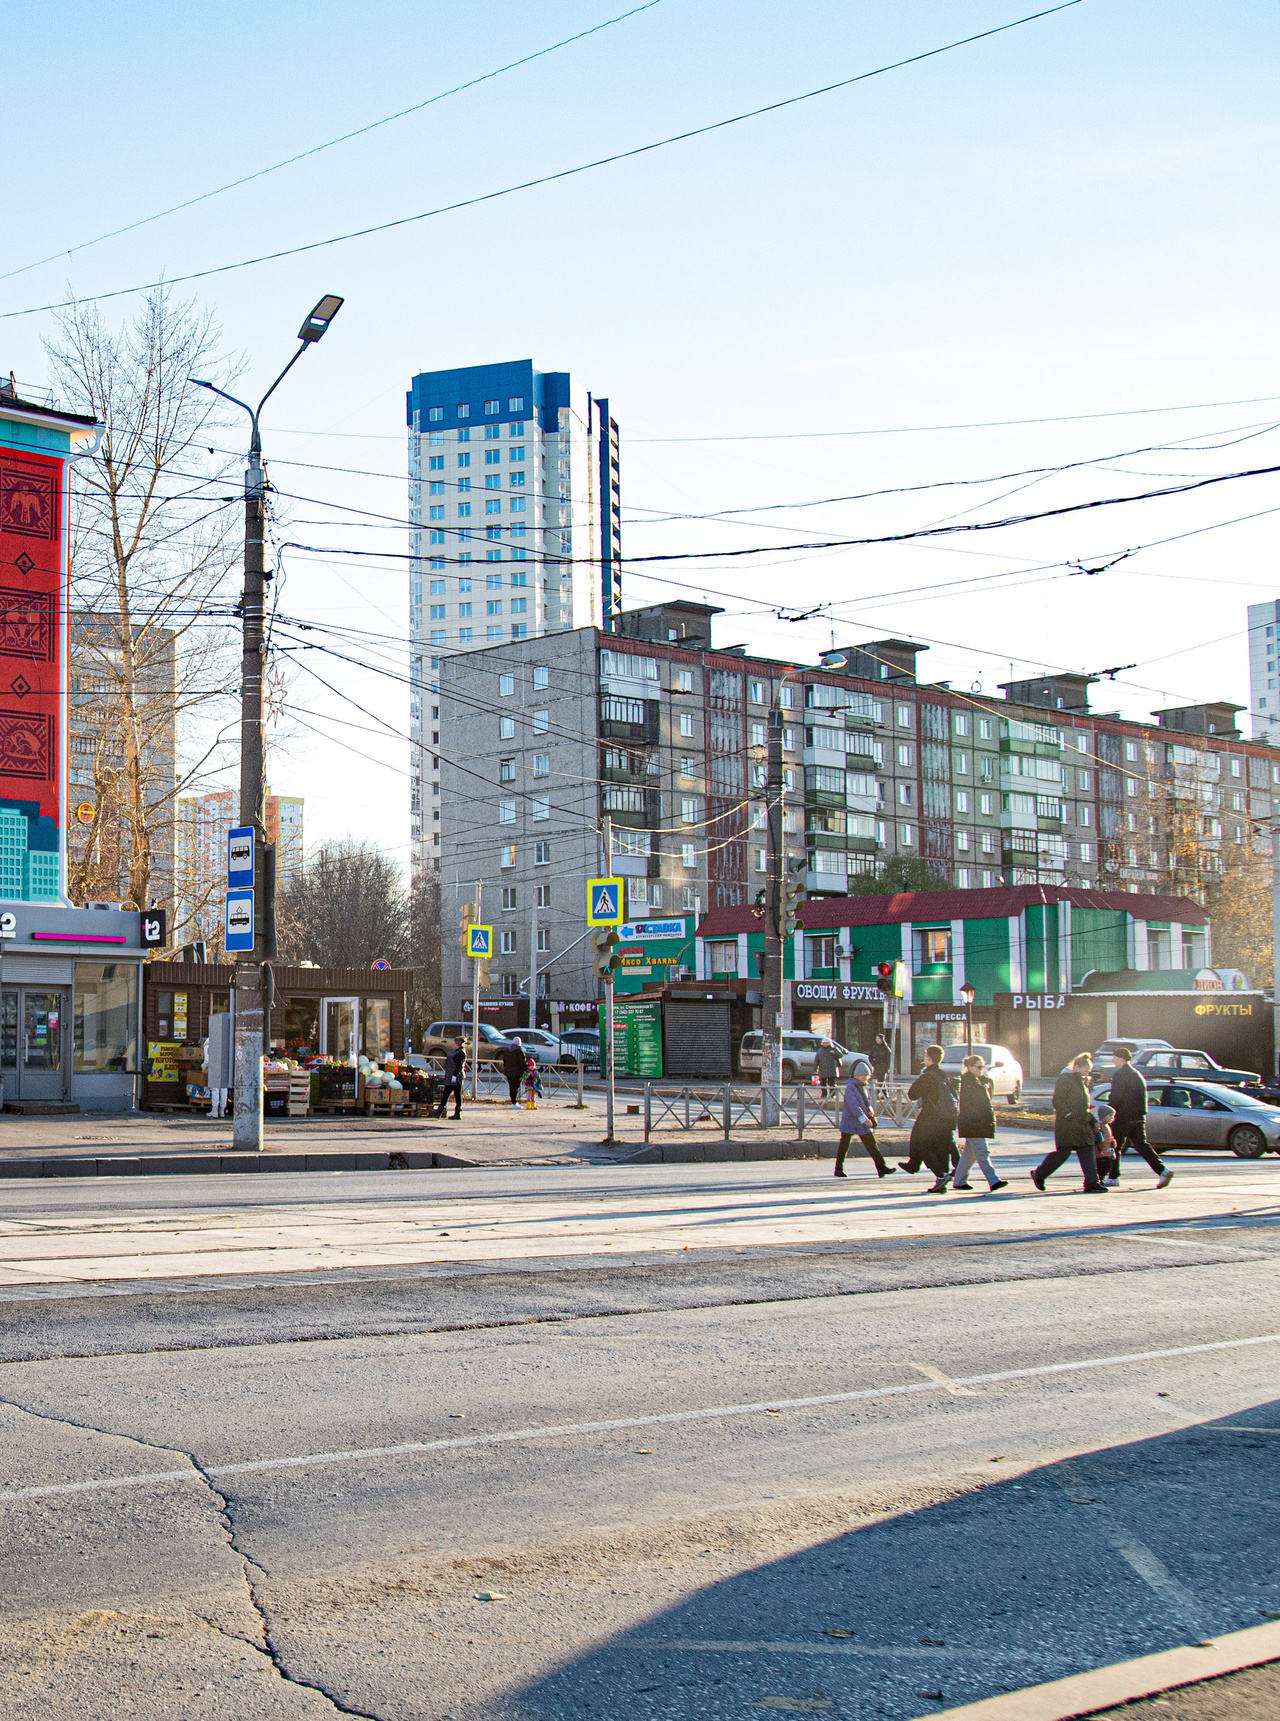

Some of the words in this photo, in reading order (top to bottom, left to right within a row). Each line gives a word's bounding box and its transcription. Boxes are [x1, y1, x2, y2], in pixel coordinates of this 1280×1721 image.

[142, 918, 160, 941] t2
[646, 957, 677, 965] Халяль
[797, 984, 837, 1001] ОВОЩИ
[569, 1003, 592, 1012] КОФЕ
[1014, 995, 1065, 1009] РЫБА
[1195, 1004, 1252, 1016] ФРУКТЫ
